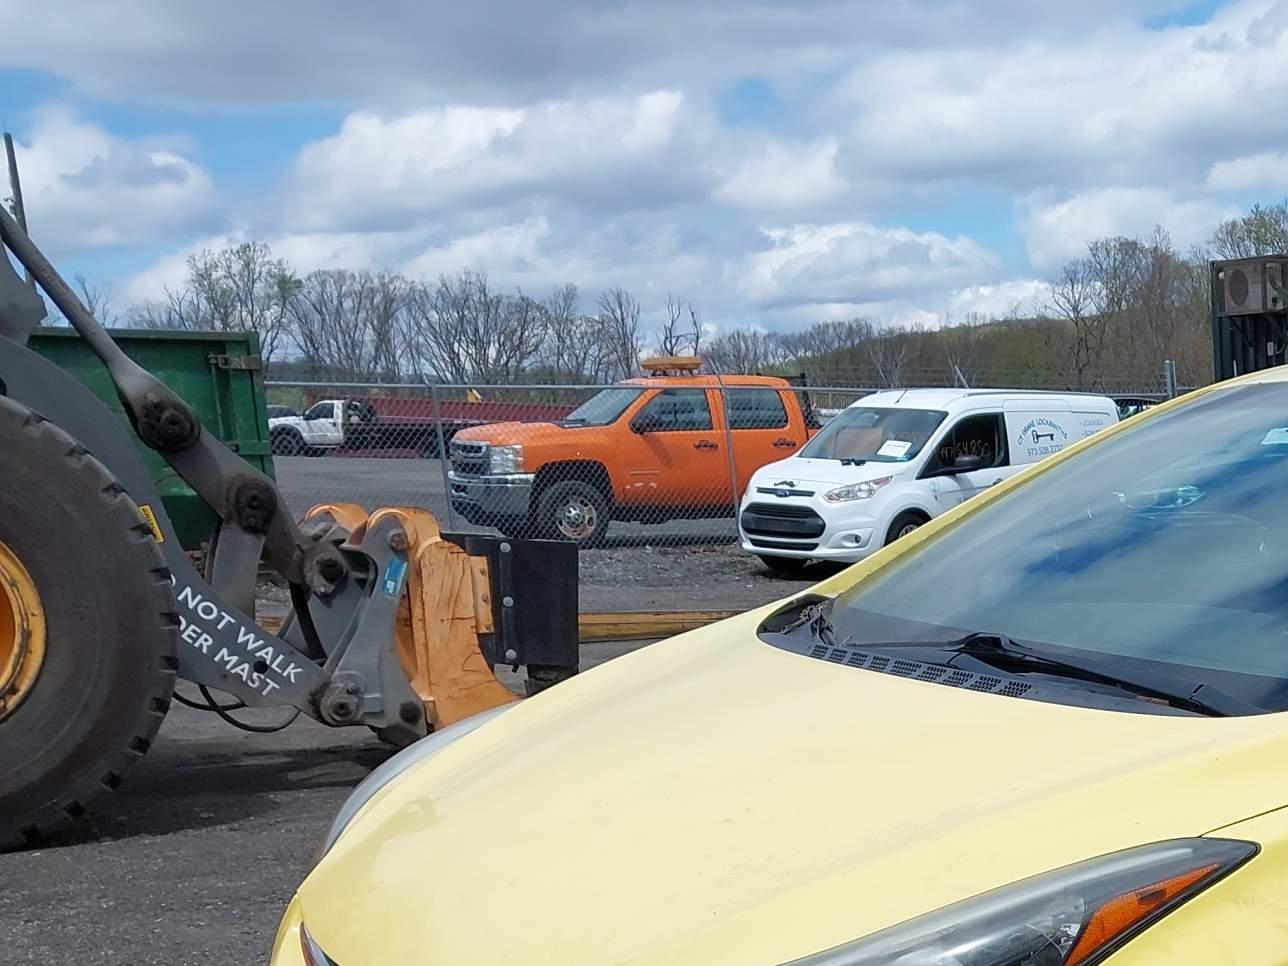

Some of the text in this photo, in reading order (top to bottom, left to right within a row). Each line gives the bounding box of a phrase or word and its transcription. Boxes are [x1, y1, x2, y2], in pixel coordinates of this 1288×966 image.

[177, 586, 304, 684] NOT WALK
[213, 647, 281, 696] MAST
